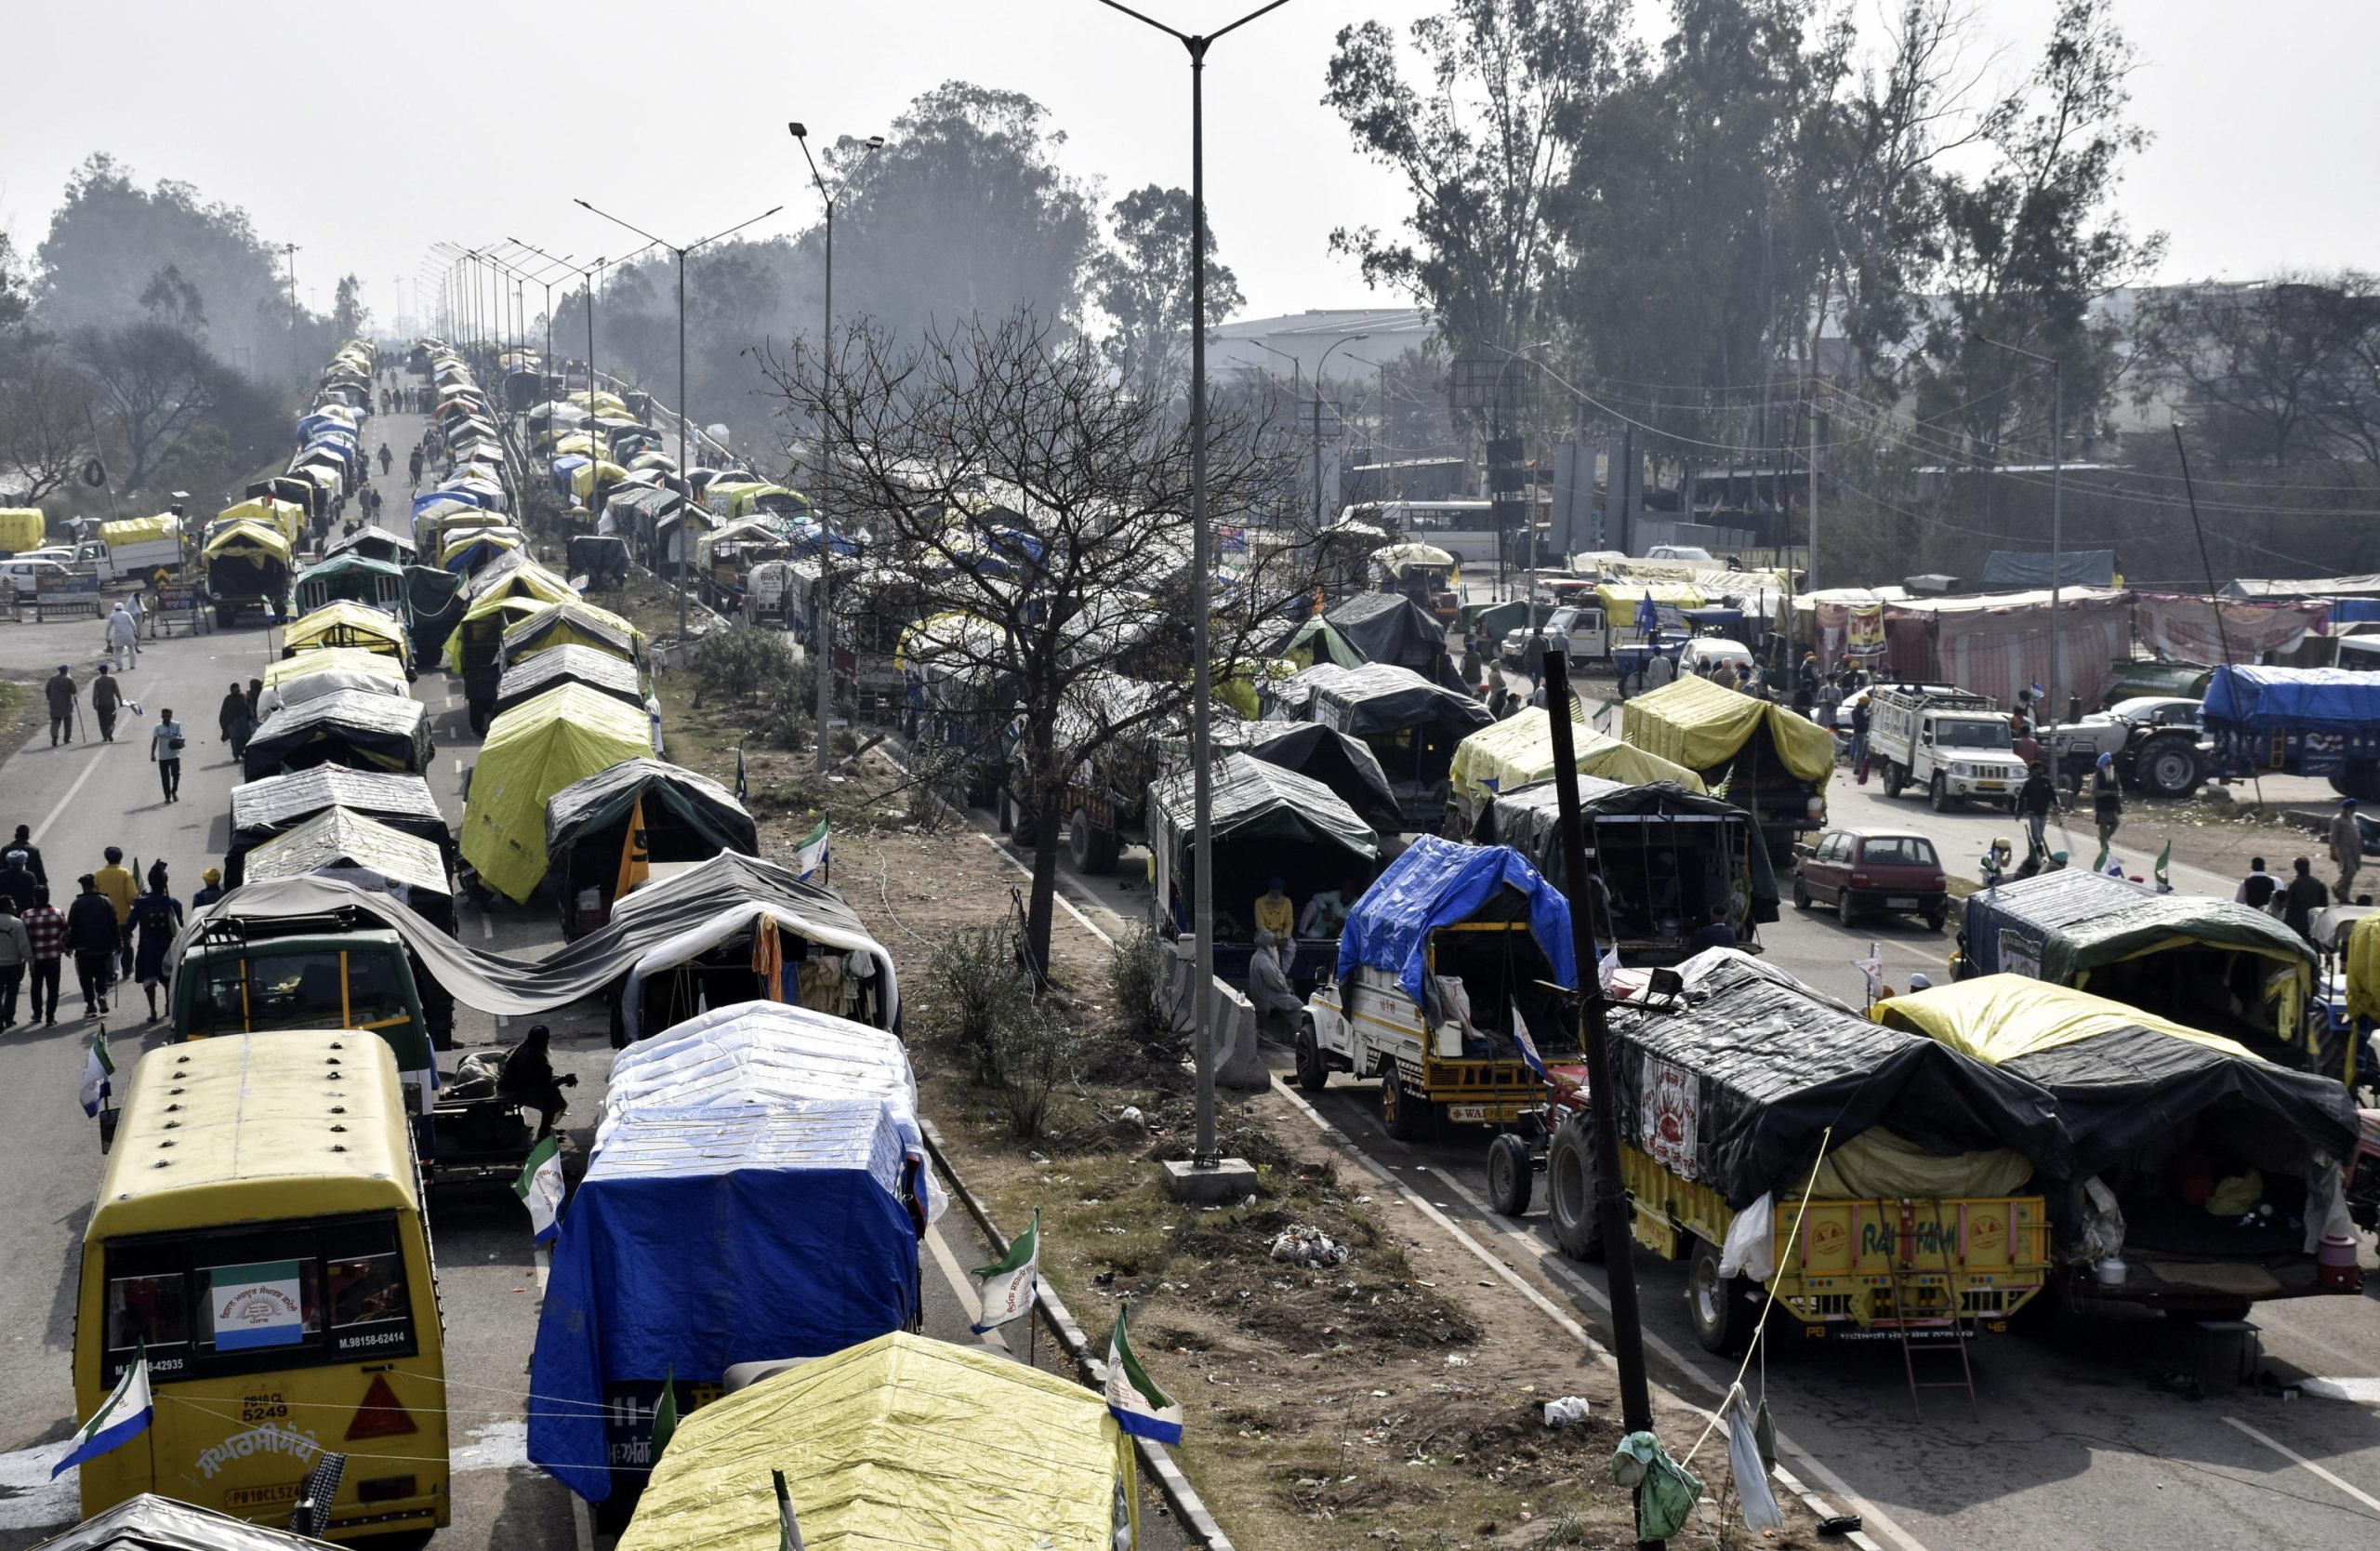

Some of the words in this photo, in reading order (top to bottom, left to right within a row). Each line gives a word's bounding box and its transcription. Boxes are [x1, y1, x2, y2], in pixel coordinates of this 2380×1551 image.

[1805, 1325, 1826, 1338] PB
[1987, 1320, 2007, 1332] 46
[339, 1331, 405, 1349] M.98158-62414
[244, 1395, 270, 1408] PB10
[271, 1392, 284, 1405] CL
[242, 1405, 288, 1422] 5249
[233, 1486, 302, 1505] PB10CL524
